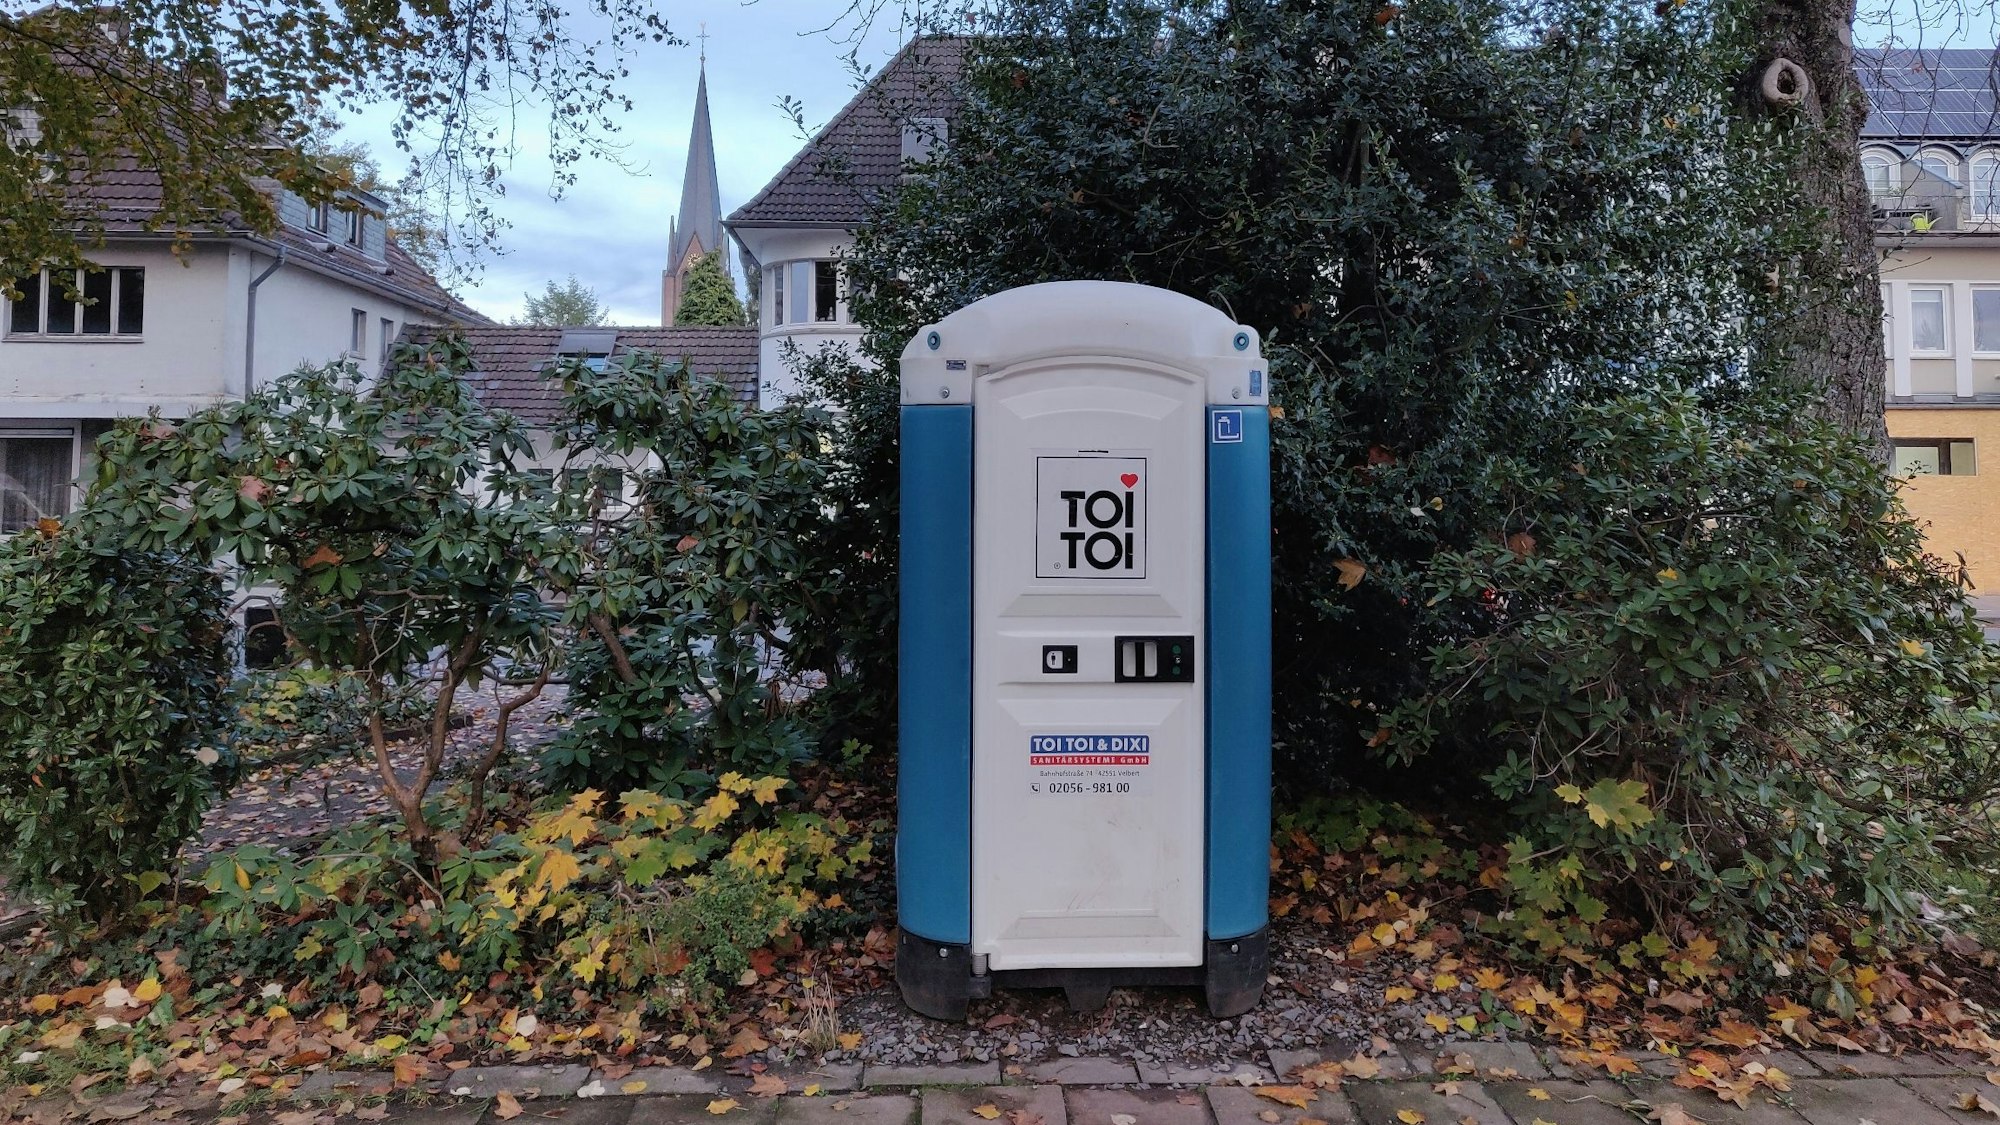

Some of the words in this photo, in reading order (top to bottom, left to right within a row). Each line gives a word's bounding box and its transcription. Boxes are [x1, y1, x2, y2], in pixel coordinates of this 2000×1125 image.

[1061, 490, 1134, 528] TOI
[1060, 531, 1133, 570] TOI
[1034, 738, 1061, 751] TOI
[1066, 738, 1093, 751] TOI
[1097, 738, 1108, 751] &
[1112, 738, 1147, 751] DIXI
[1033, 755, 1115, 764] SANITÄRSYSTEME
[1120, 756, 1147, 764] GmbH
[1049, 782, 1083, 793] 02056
[1092, 782, 1112, 793] 981
[1116, 782, 1130, 793] 00
